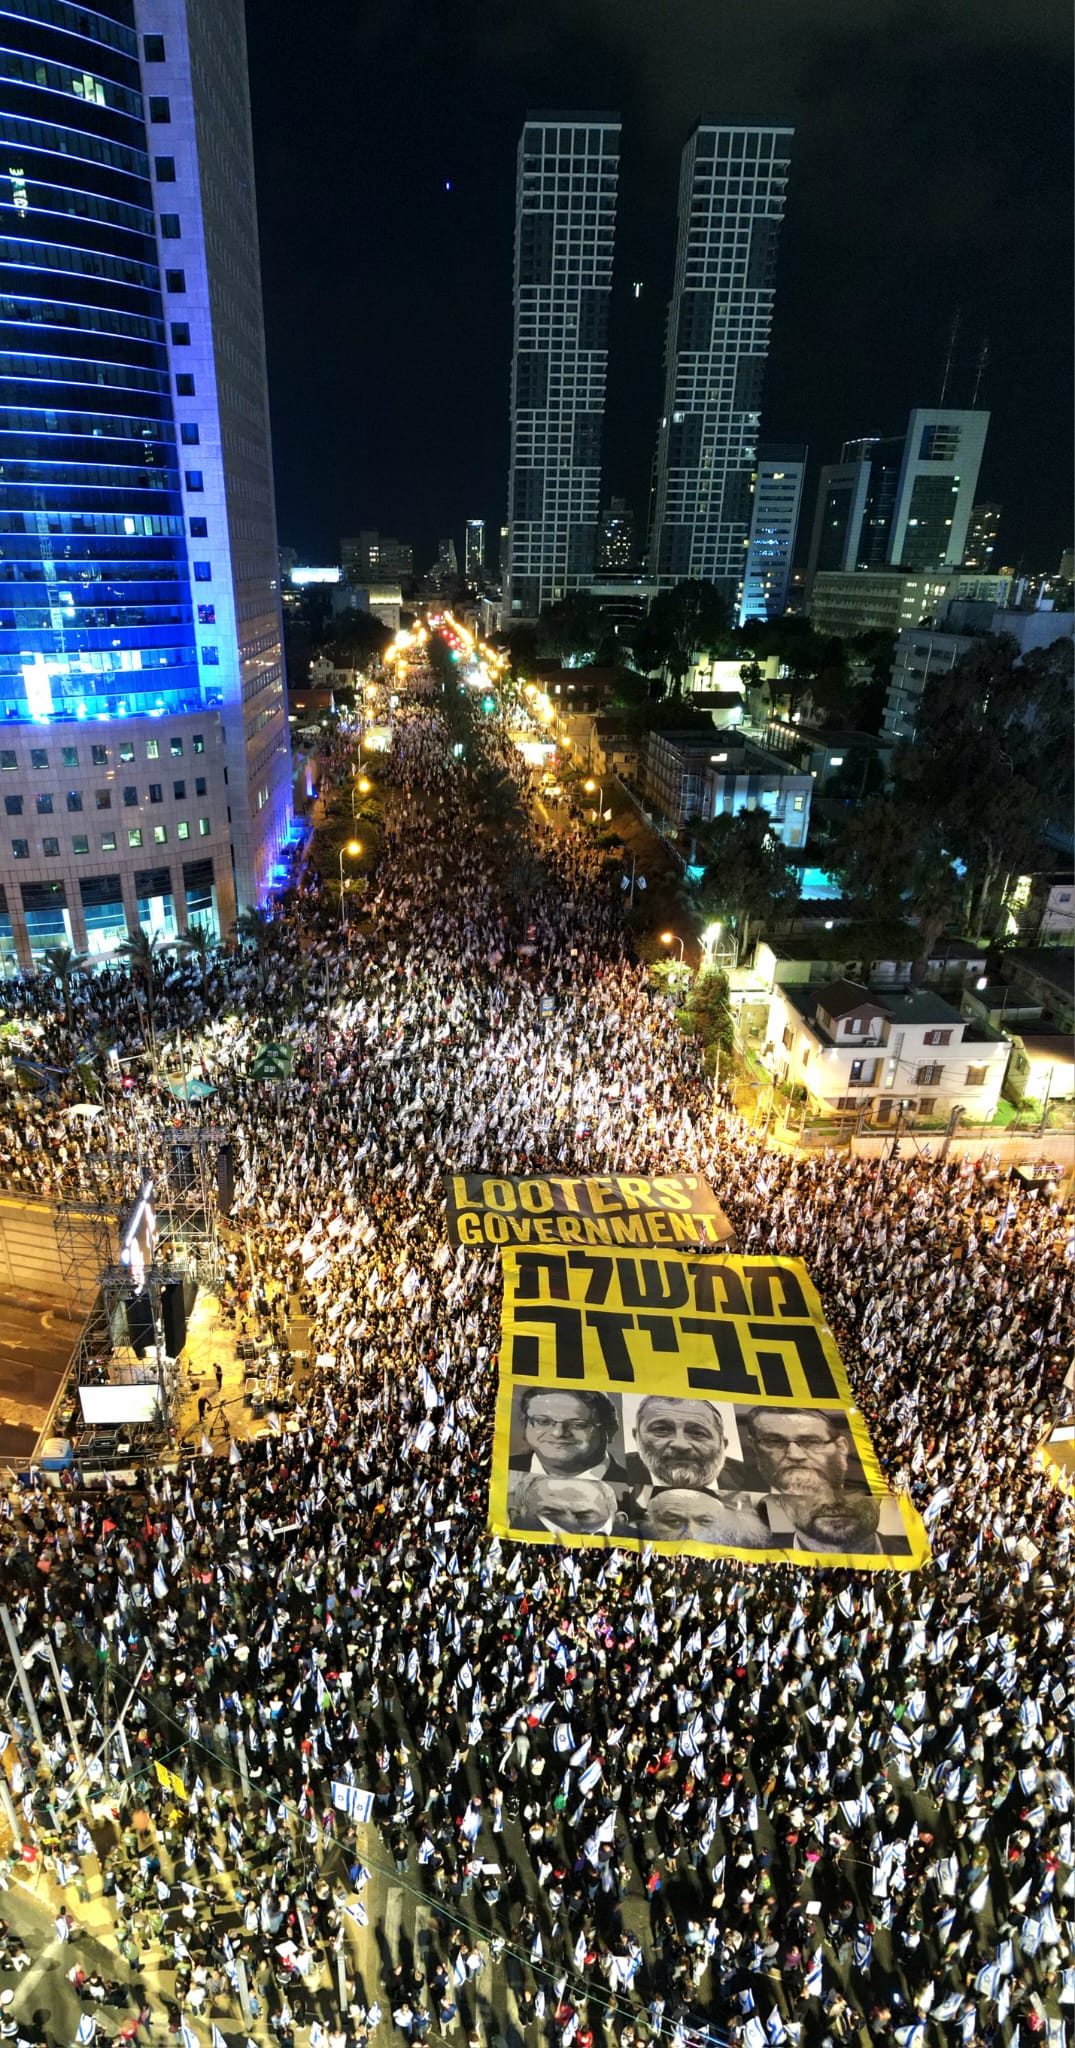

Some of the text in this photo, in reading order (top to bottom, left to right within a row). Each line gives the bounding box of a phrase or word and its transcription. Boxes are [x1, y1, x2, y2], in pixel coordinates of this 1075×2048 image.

[452, 1177, 698, 1213] LOOTERS'
[457, 1211, 718, 1245] GOVERNMENT
[514, 1250, 811, 1318] ממשלת
[512, 1305, 840, 1400] הביזה
